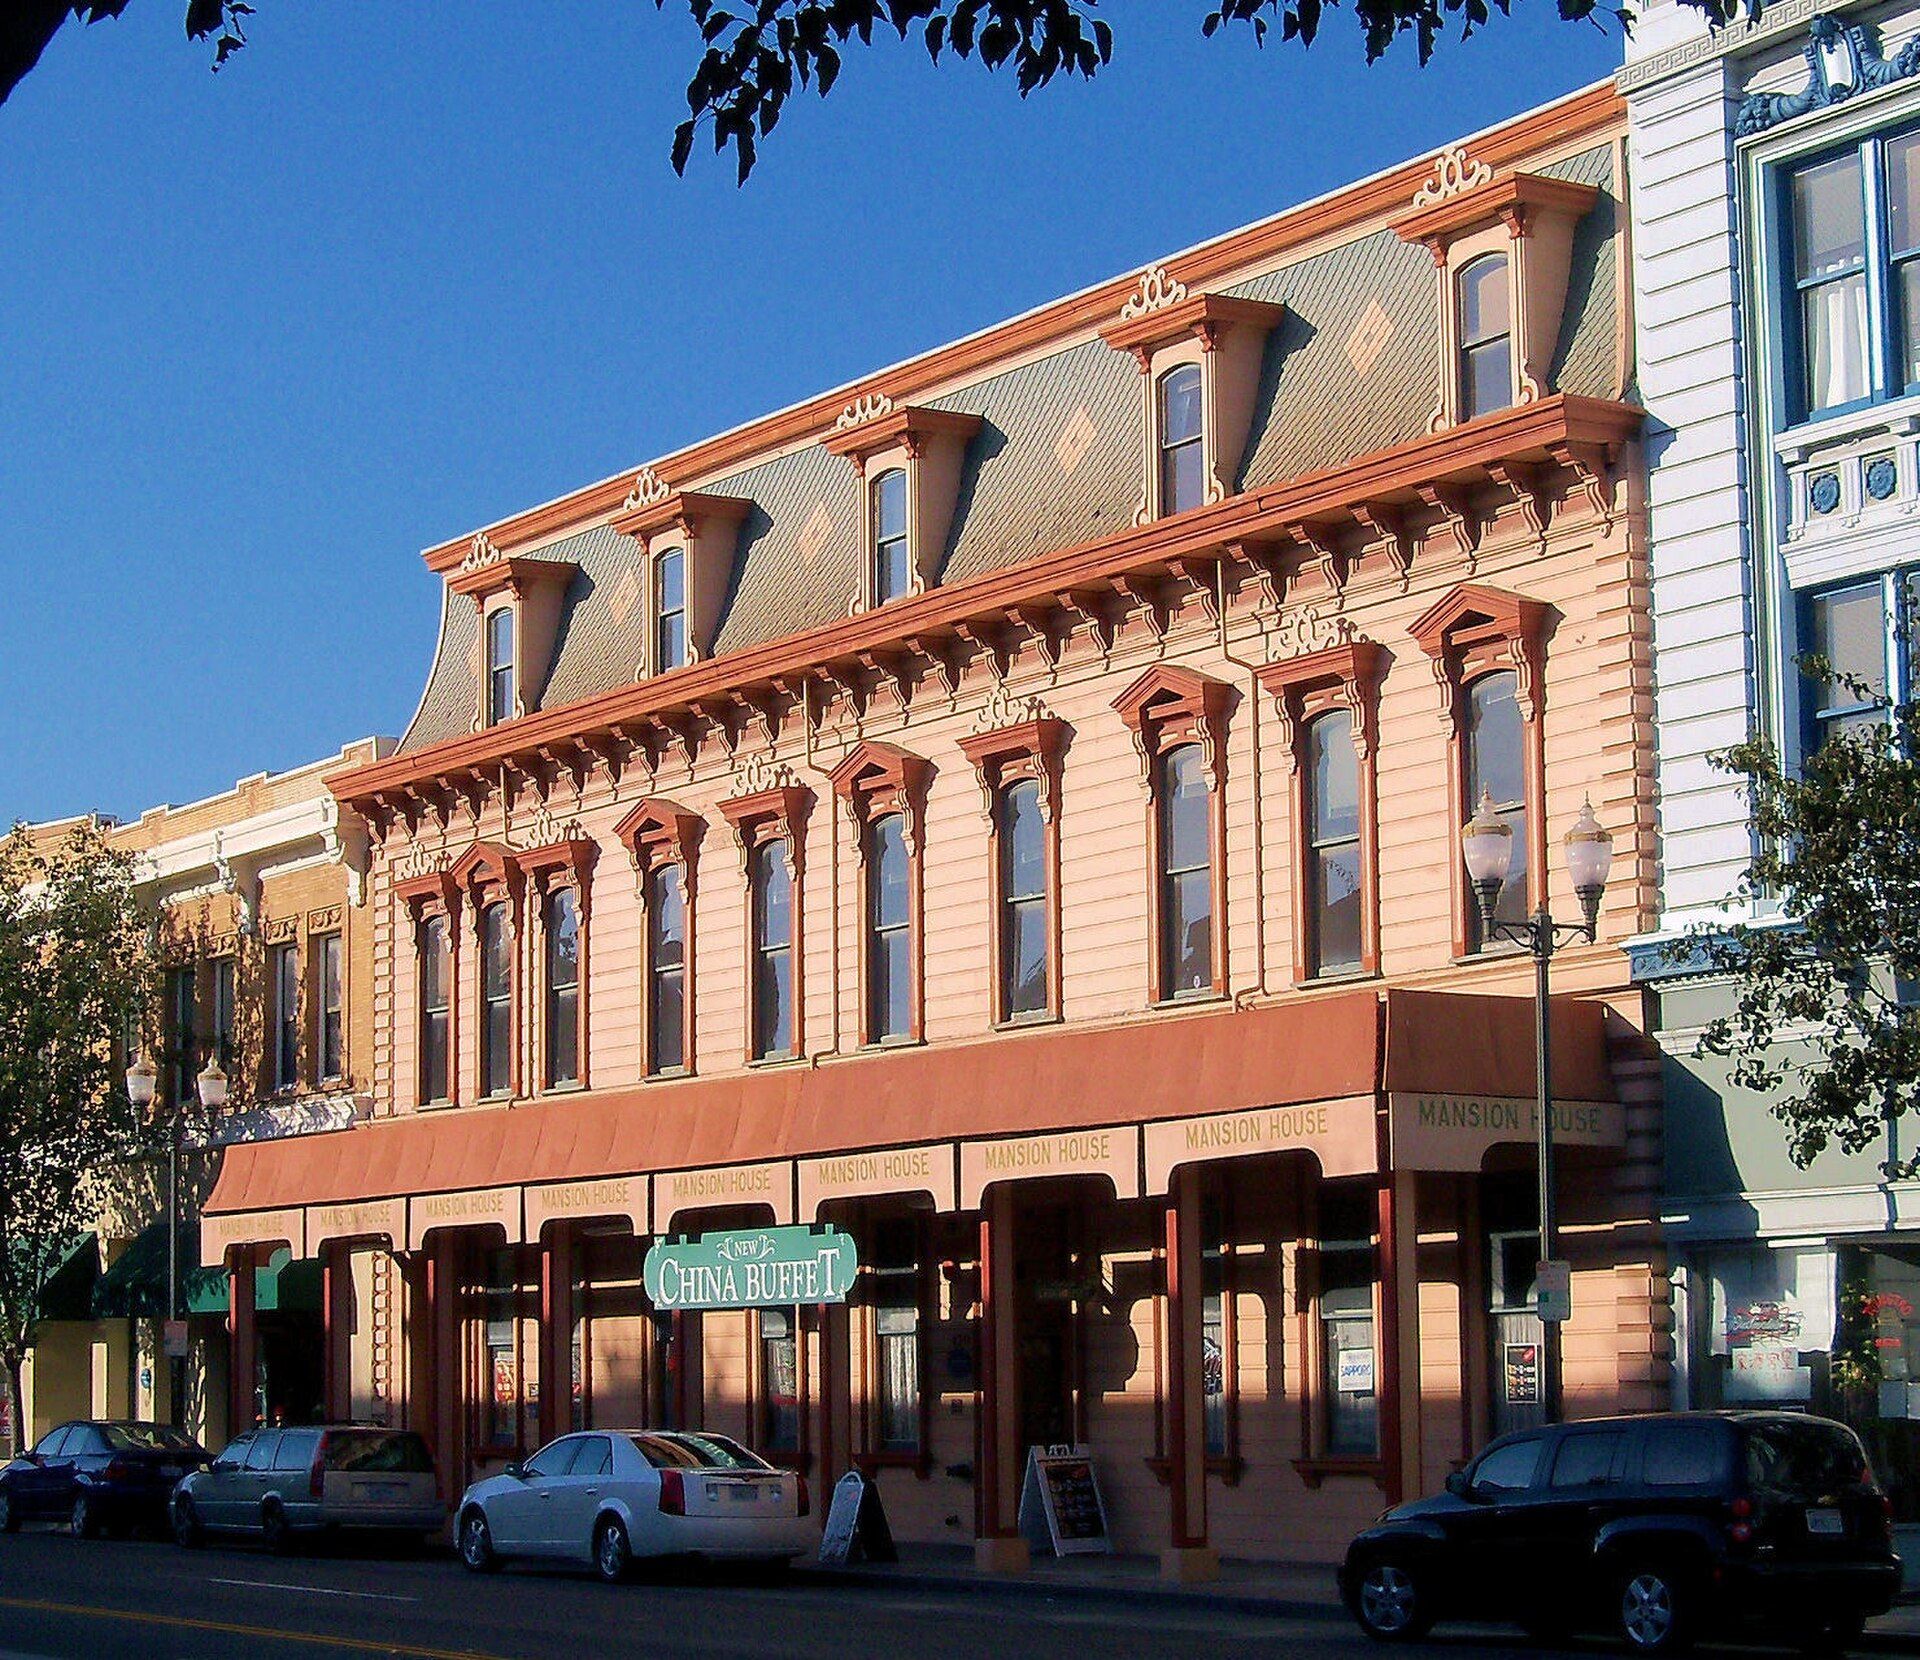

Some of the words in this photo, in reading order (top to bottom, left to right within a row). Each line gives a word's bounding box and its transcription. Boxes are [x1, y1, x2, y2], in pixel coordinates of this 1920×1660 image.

[1186, 1116, 1261, 1149] MANSION
[1269, 1108, 1328, 1139] HOUSE
[1418, 1100, 1520, 1130] MANSION
[985, 1140, 1051, 1169] MANSION
[1059, 1134, 1110, 1162] HOUSE
[673, 1174, 725, 1197] MANSION
[731, 1169, 771, 1192] HOUSE
[819, 1157, 878, 1184] MANSION
[885, 1152, 930, 1177] HOUSE
[425, 1195, 468, 1217] MANSION
[471, 1193, 503, 1213] HOUSE
[541, 1185, 589, 1209] MANSION
[593, 1182, 629, 1205] HOUSE
[734, 1239, 760, 1257] NEW
[659, 1258, 740, 1305] CHINA
[744, 1248, 841, 1302] BUFFET
